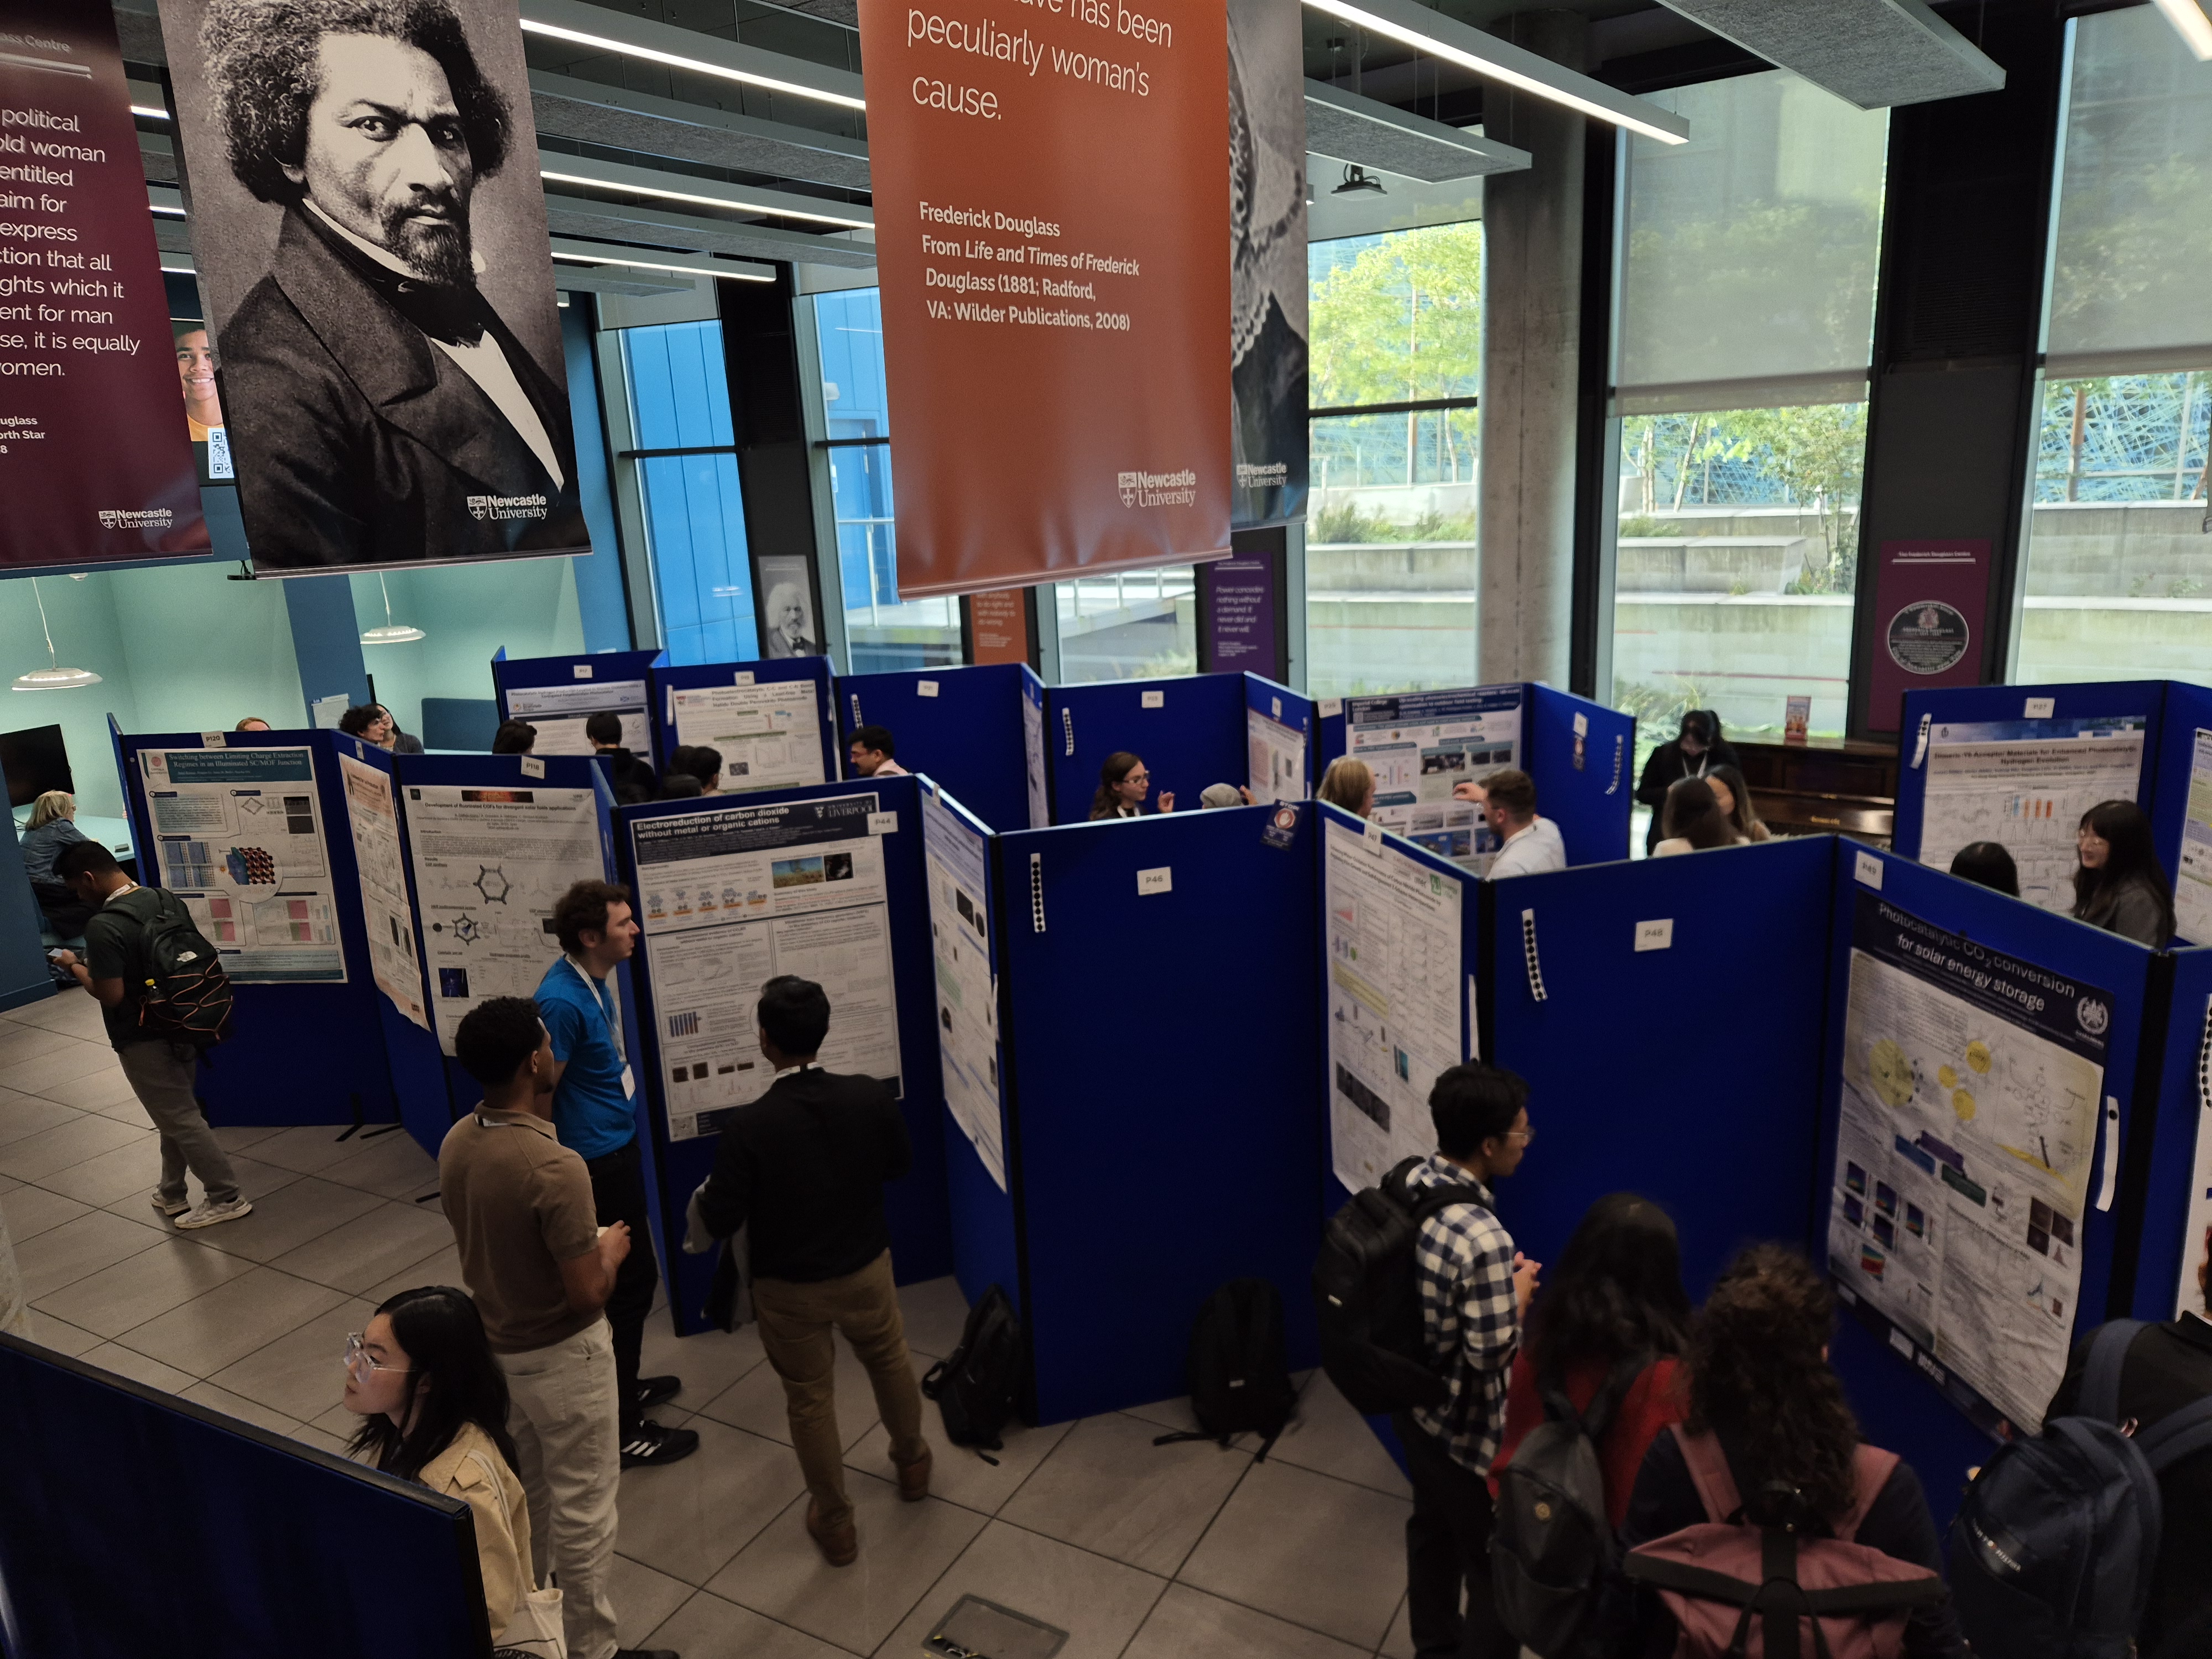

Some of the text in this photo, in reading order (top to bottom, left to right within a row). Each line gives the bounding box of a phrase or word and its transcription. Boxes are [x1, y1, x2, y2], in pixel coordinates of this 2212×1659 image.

[1118, 0, 1172, 48] been
[907, 8, 1149, 96] peculiarly woman's
[912, 76, 1001, 120] cause.
[2, 108, 81, 133] political
[30, 140, 106, 163] woman
[0, 164, 74, 186] entitled
[0, 190, 67, 213] aim for
[920, 201, 1060, 238] Frederick Douglass
[0, 222, 77, 242] express
[0, 247, 113, 271] tion that all
[922, 234, 1140, 276] From Life and Times of Frederick
[0, 275, 124, 298] ghts which it
[926, 268, 1096, 301] Douglass (1881; Radford,
[0, 304, 113, 324] ent for man
[926, 300, 1130, 331] VA: Wilder Publications, 2008)
[0, 331, 140, 355] se, it is equally
[0, 362, 65, 376] omen.
[22, 430, 45, 439] Star
[1137, 468, 1196, 489] Newcastle
[1248, 462, 1287, 476] Newcastle
[1248, 473, 1287, 488] University
[487, 494, 546, 508] Newcastle
[1138, 488, 1196, 507] University
[117, 508, 172, 519] Newcastle
[118, 517, 173, 529] University
[488, 506, 547, 520] University
[526, 762, 540, 771] P118
[830, 805, 873, 817] LIVERPOOL
[1280, 801, 1300, 811] STOP!
[637, 816, 711, 831] Electroreduction
[725, 810, 755, 821] carbon
[758, 806, 790, 817] dioxide
[638, 827, 672, 839] without
[674, 826, 698, 835] metal
[712, 821, 745, 831] organic
[748, 817, 780, 827] cations
[1368, 832, 1377, 842] P47
[1145, 874, 1164, 884] P46
[1644, 927, 1663, 938] P48
[1879, 901, 1960, 950] Photocatalytic
[1994, 956, 2075, 998] conversion
[1897, 933, 2045, 1011] for solar energy storage
